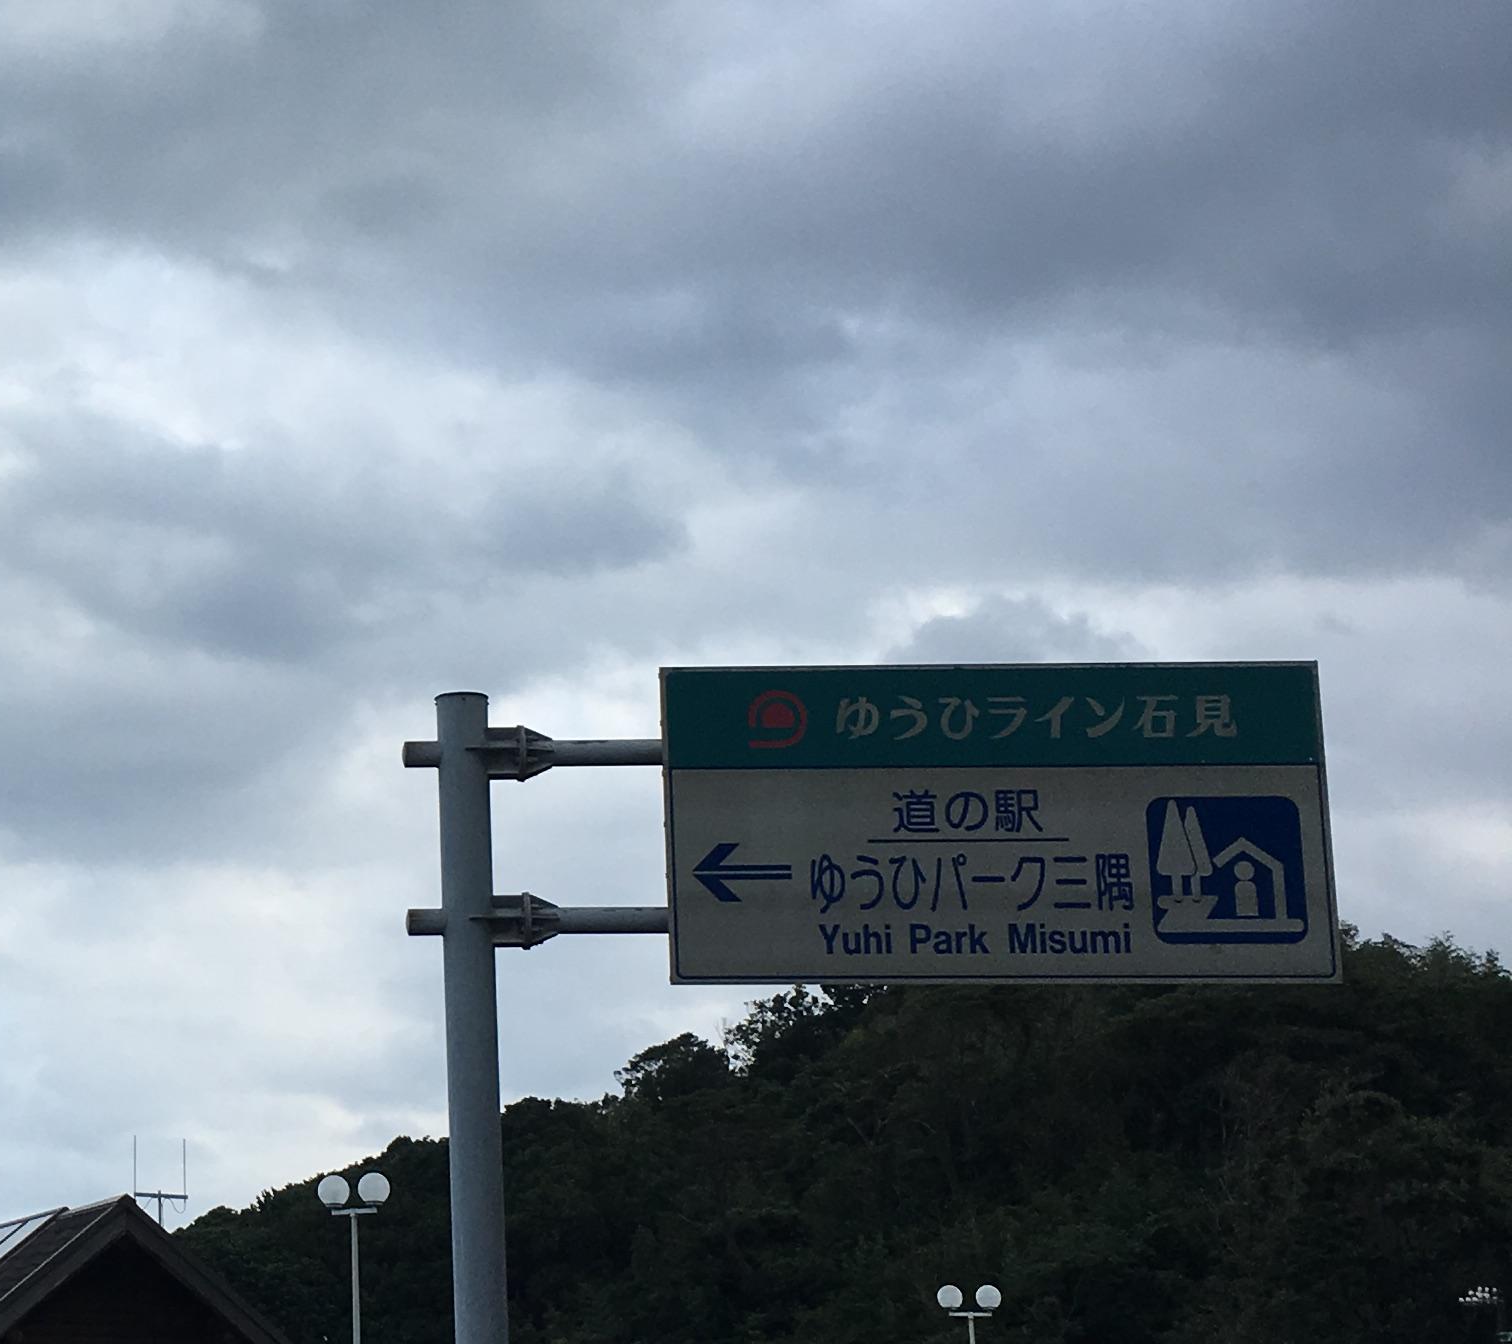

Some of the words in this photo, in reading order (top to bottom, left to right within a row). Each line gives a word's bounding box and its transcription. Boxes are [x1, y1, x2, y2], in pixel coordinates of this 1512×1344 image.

[835, 694, 1238, 741] ゆうひライン石見
[892, 789, 1044, 834] 道の駅
[810, 853, 1135, 912] ゆうひパーク三隅
[819, 924, 892, 955] Yuhi
[910, 924, 989, 954] Park
[1008, 923, 1132, 954] Misumi
